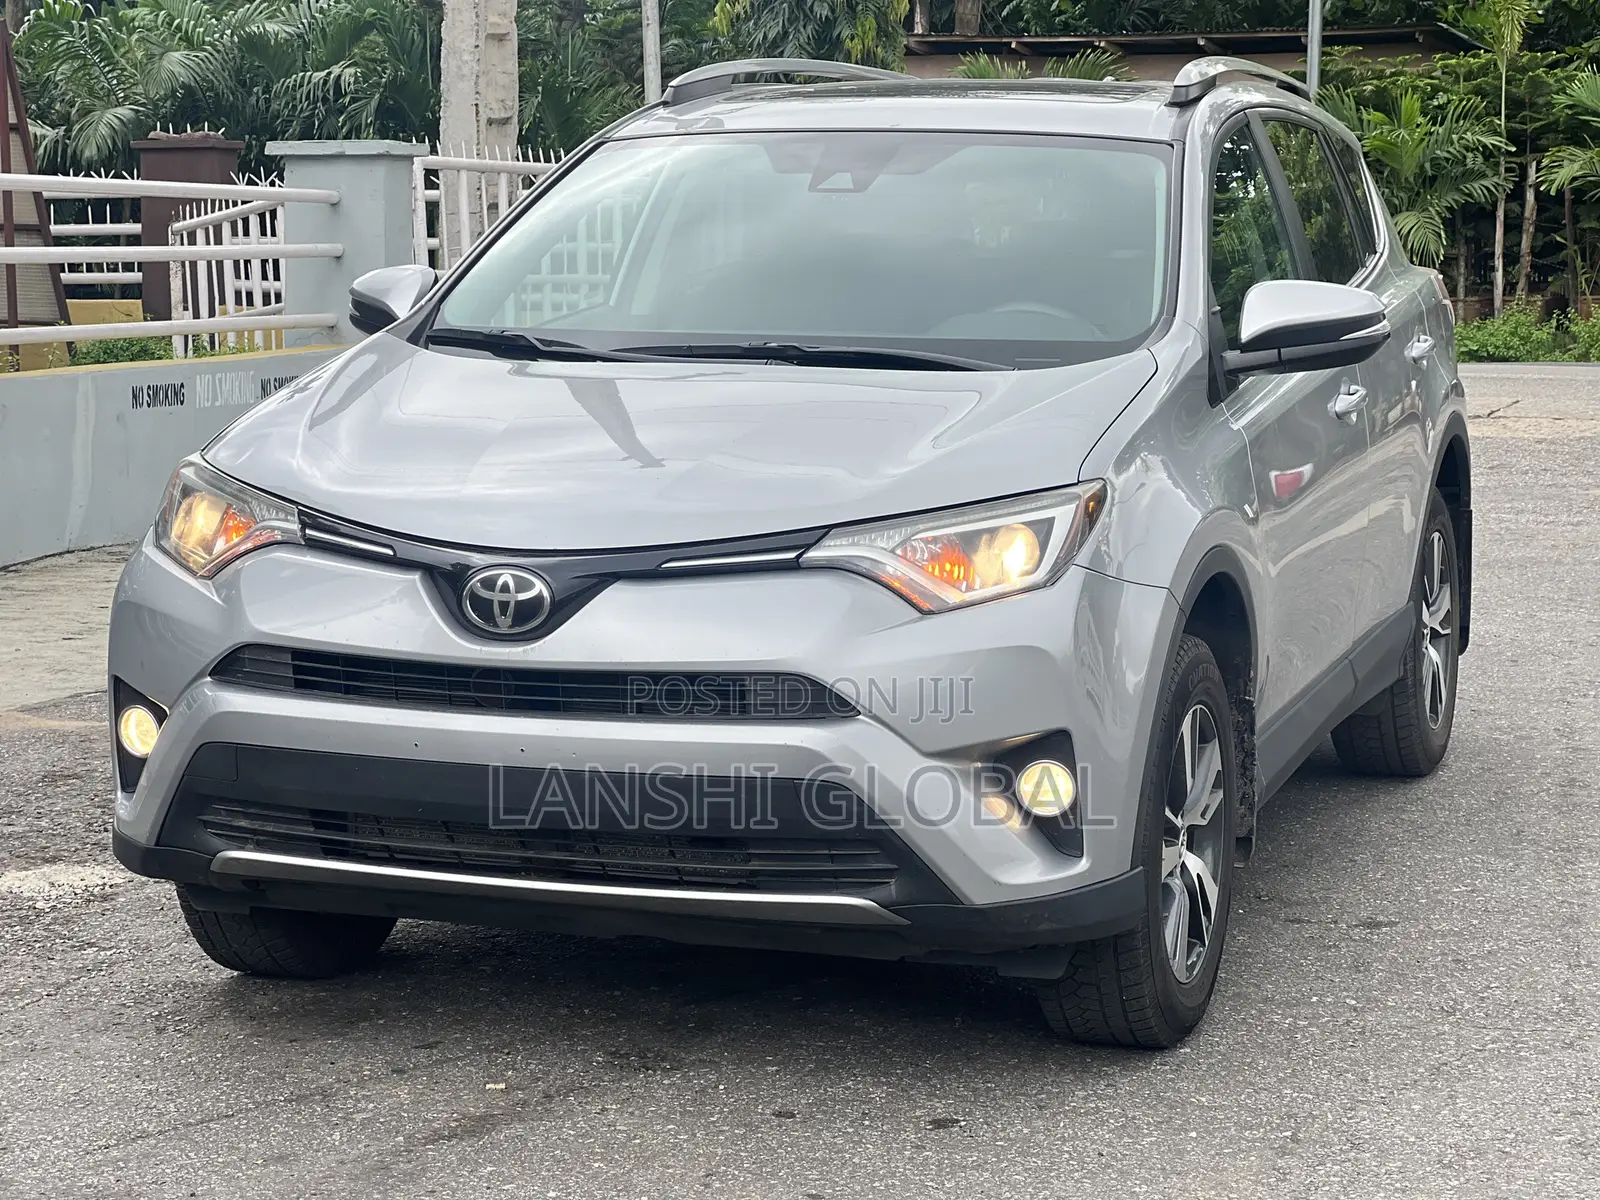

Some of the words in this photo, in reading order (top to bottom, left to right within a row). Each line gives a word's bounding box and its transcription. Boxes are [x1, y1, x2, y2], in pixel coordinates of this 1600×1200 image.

[131, 386, 144, 409] NO
[146, 382, 185, 408] SMOKING
[196, 374, 213, 409] NO
[215, 370, 255, 406] SMOKING
[260, 378, 272, 400] NO
